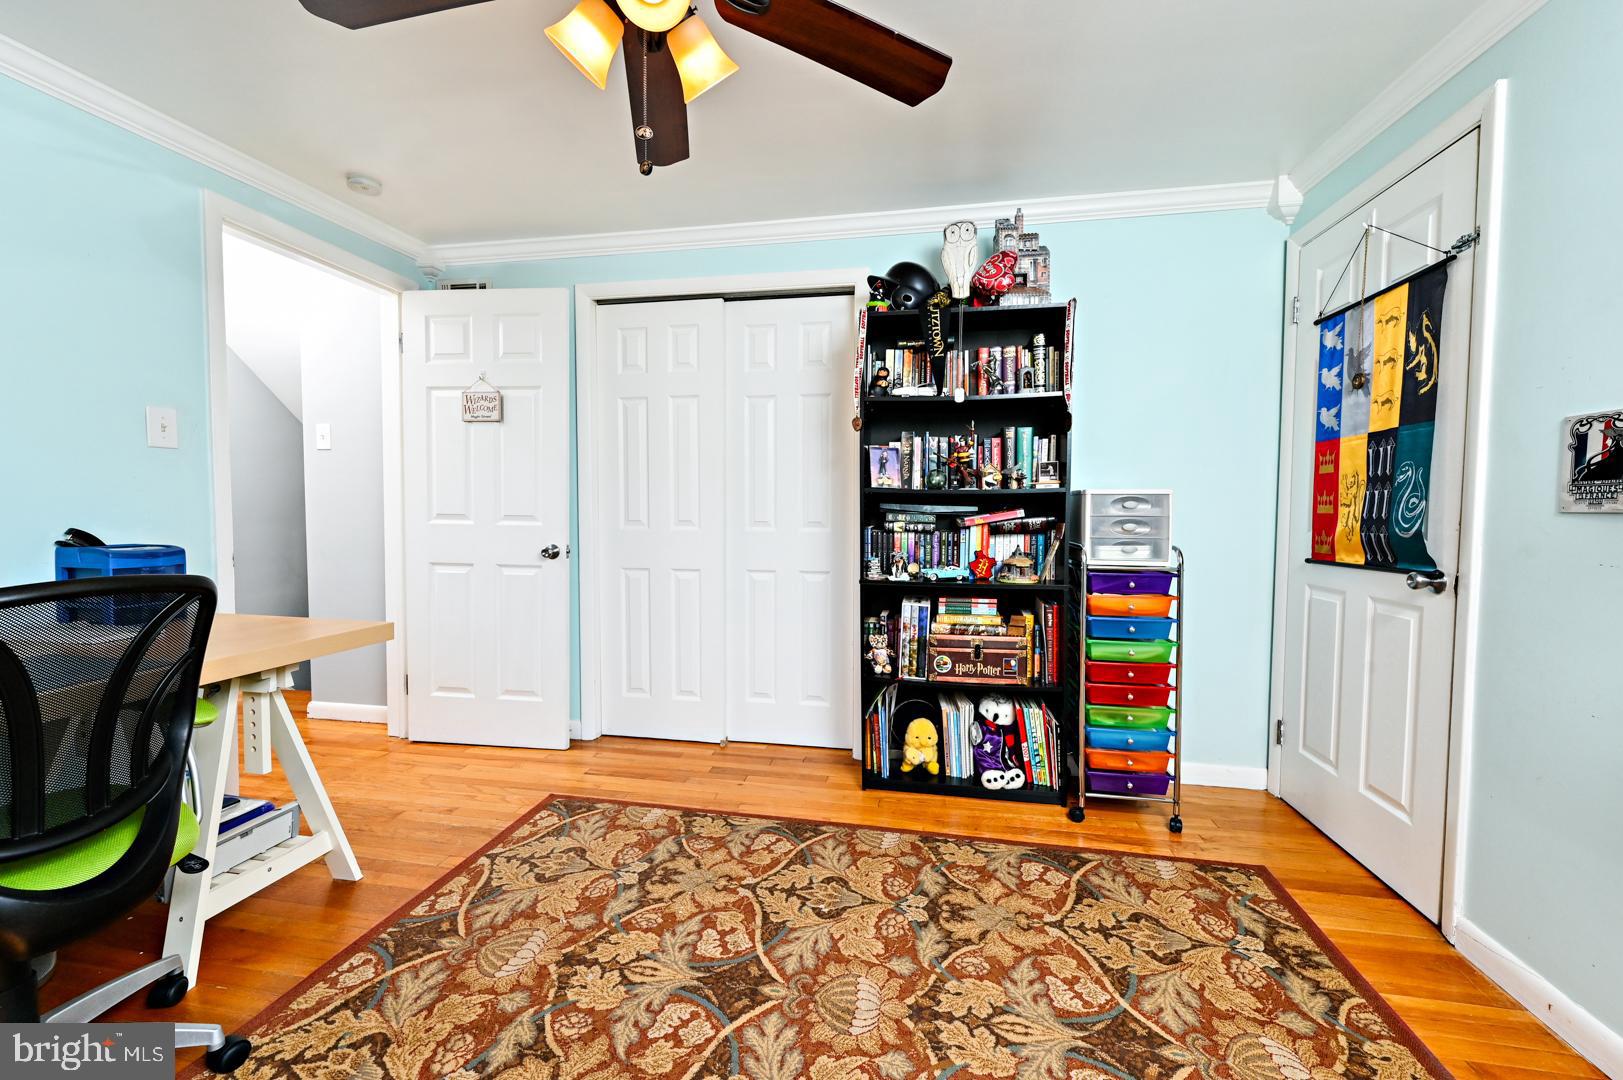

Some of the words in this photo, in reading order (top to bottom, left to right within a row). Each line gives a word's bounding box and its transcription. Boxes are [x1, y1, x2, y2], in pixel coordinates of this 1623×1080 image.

[464, 404, 497, 415] WELCOME
[954, 663, 977, 675] Harry
[977, 662, 1002, 676] Potter
